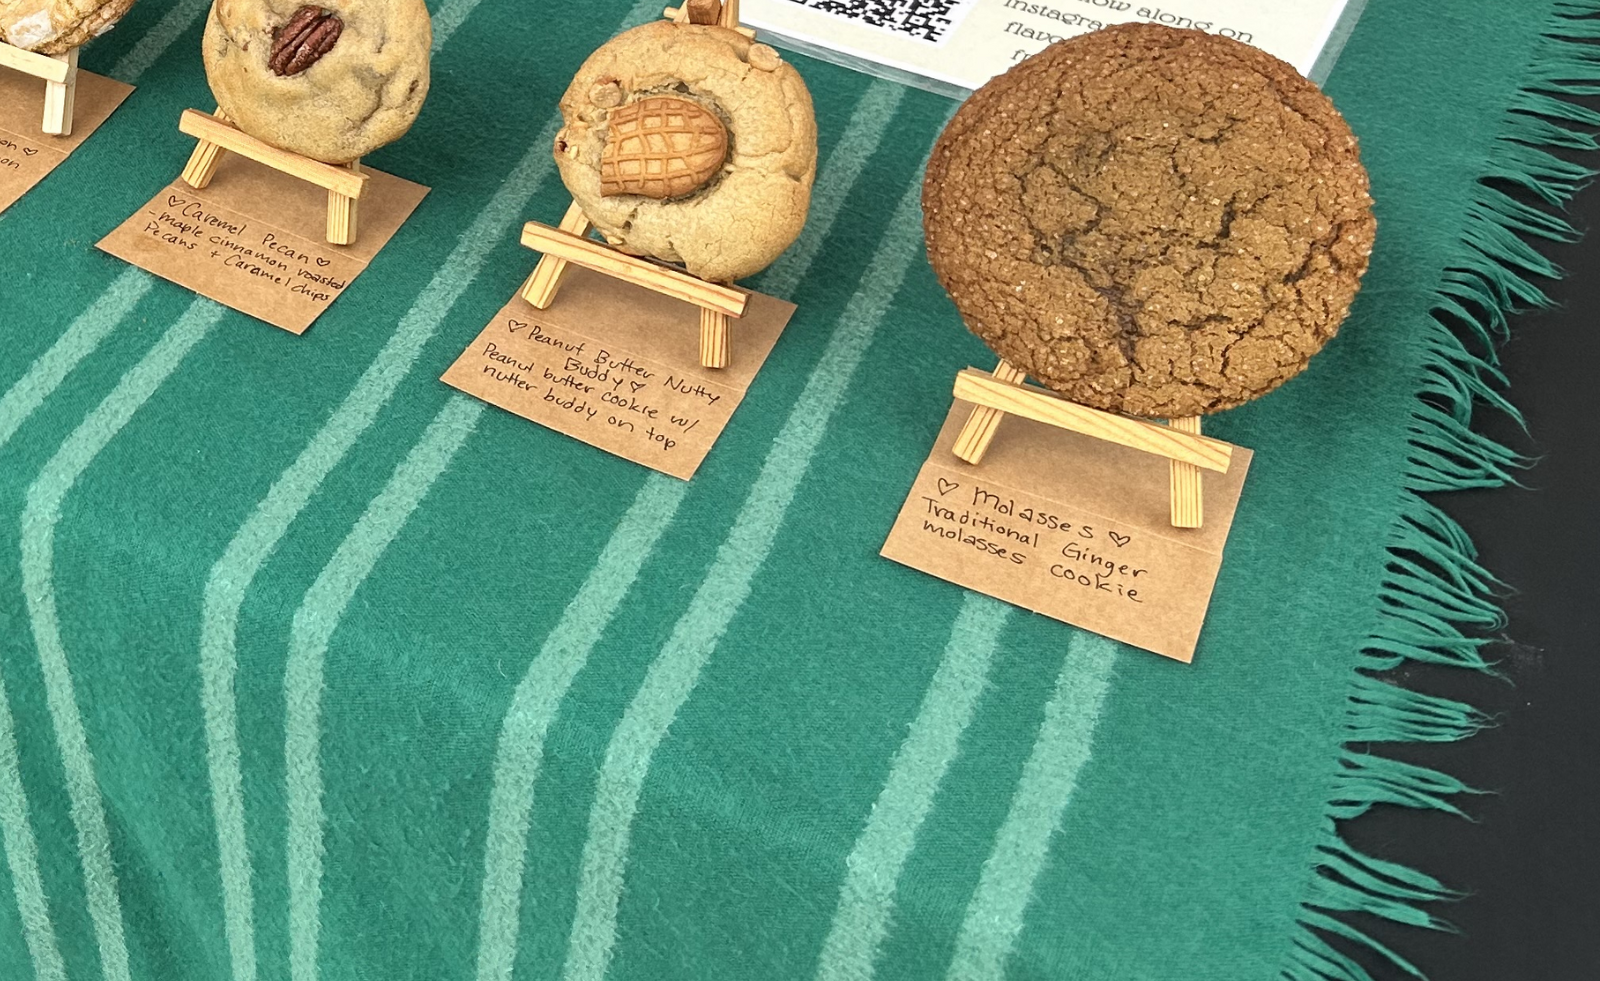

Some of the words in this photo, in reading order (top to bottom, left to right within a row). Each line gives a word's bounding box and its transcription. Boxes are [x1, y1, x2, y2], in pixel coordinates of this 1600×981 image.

[1137, 6, 1213, 33] along
[1218, 27, 1254, 43] on
[144, 221, 198, 250] Pecans
[223, 254, 290, 287] Caramel
[209, 235, 287, 271] cinnamon
[298, 268, 346, 290] roasted
[262, 233, 309, 264] Pecan
[483, 343, 535, 373] Peanut
[544, 368, 595, 394] butter
[601, 390, 658, 419] cookie
[671, 414, 700, 433] w/
[528, 326, 586, 355] Peanut
[594, 350, 655, 379] Butter
[664, 376, 721, 405] Nutty
[564, 358, 624, 391] Buddy
[483, 365, 538, 391] nutter
[544, 389, 598, 421] buddy
[608, 415, 635, 432] on
[645, 428, 676, 450] top
[922, 496, 1039, 548] Traditional
[1062, 542, 1148, 579] Ginger
[923, 521, 1027, 565] molasses
